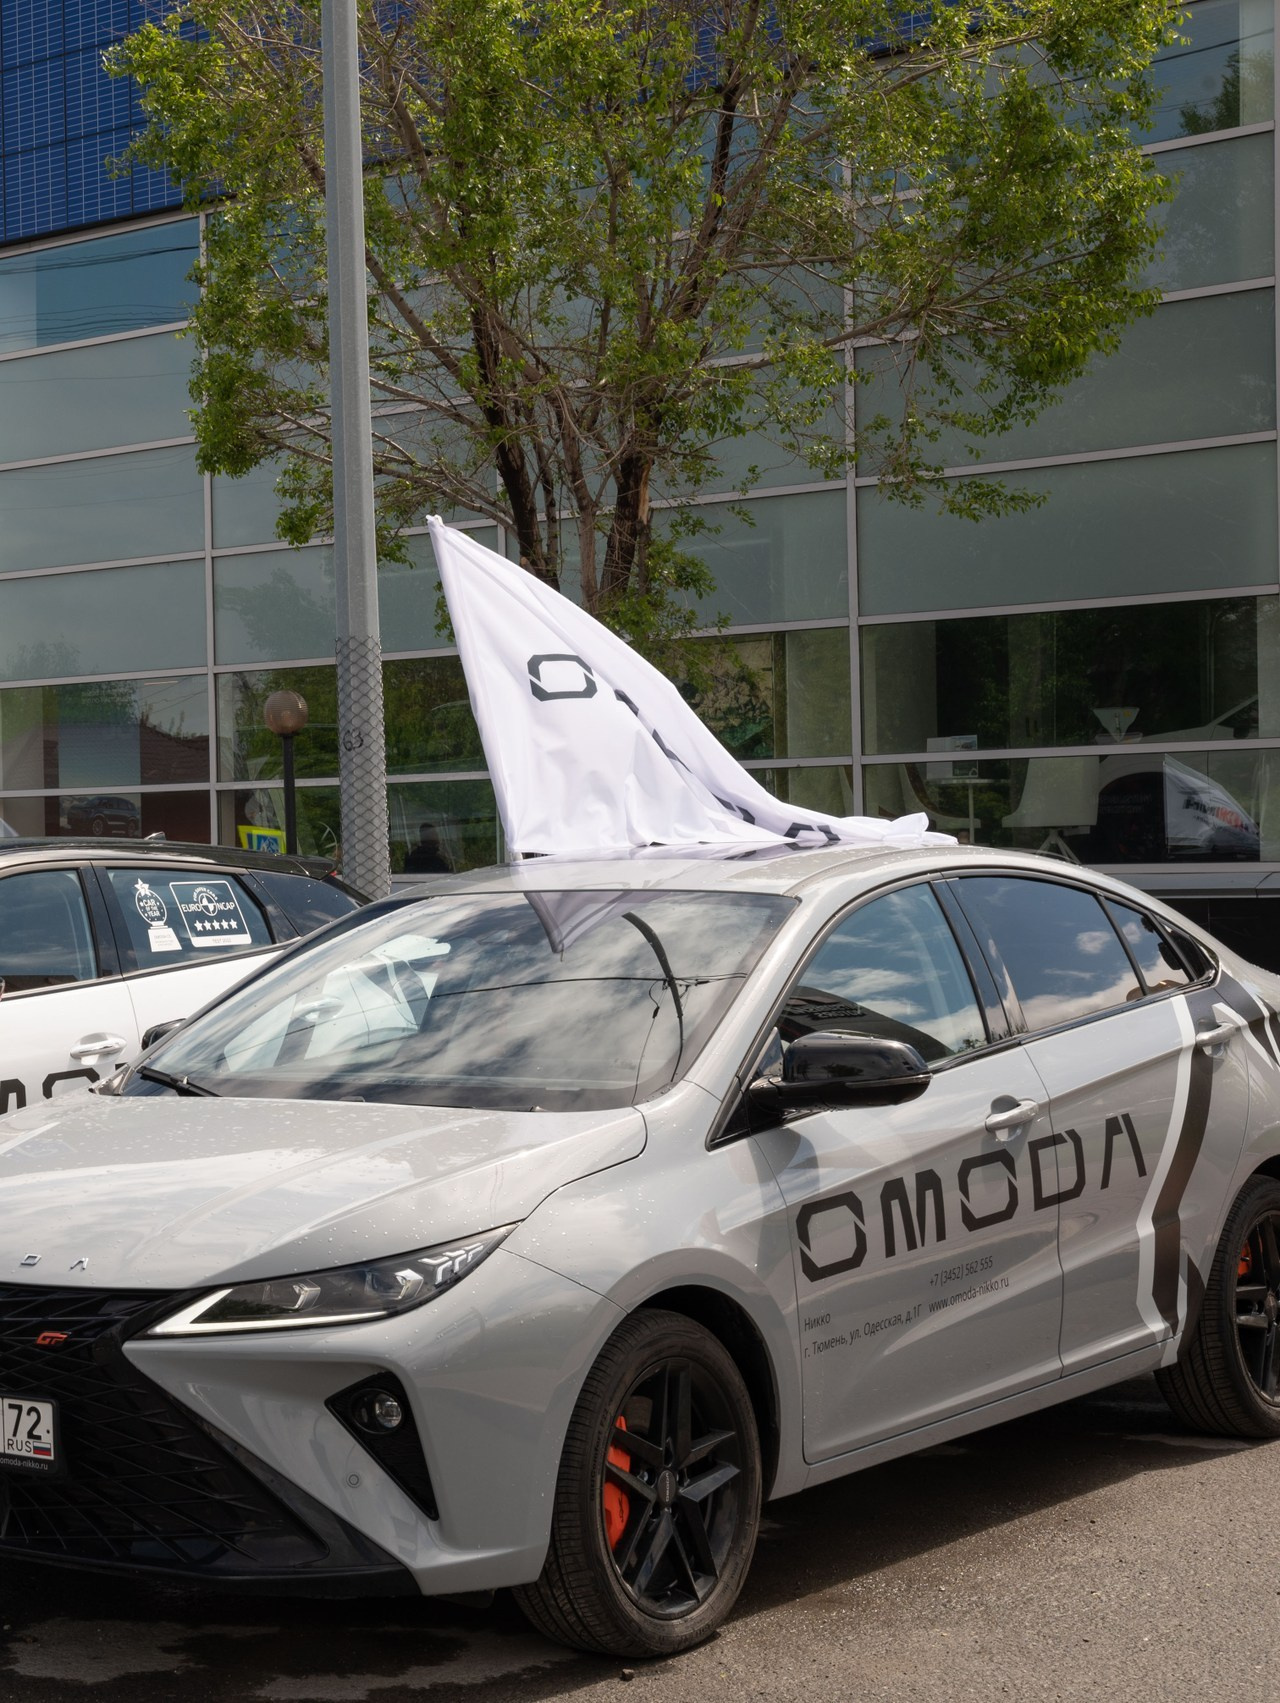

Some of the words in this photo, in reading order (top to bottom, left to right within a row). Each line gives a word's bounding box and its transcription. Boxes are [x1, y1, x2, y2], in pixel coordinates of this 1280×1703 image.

[342, 728, 364, 752] 63
[143, 899, 157, 907] CAR
[147, 909, 161, 917] YEAR
[181, 903, 202, 913] EURO
[216, 901, 235, 911] NCAP
[795, 1113, 1148, 1283] OMODA
[929, 1273, 940, 1287] +7
[940, 1265, 964, 1288] (3452)
[965, 1261, 979, 1277] 562
[979, 1255, 994, 1272] 555
[928, 1276, 1010, 1313] www.omoda-nikko.ru
[804, 1313, 831, 1332] Никко
[35, 1332, 69, 1346] GT
[804, 1347, 810, 1359] г.
[812, 1332, 848, 1355] Тюмень,
[849, 1328, 862, 1346] ул.
[863, 1312, 905, 1336] Одесская,
[8, 1403, 43, 1441] 72
[7, 1438, 32, 1453] RUS
